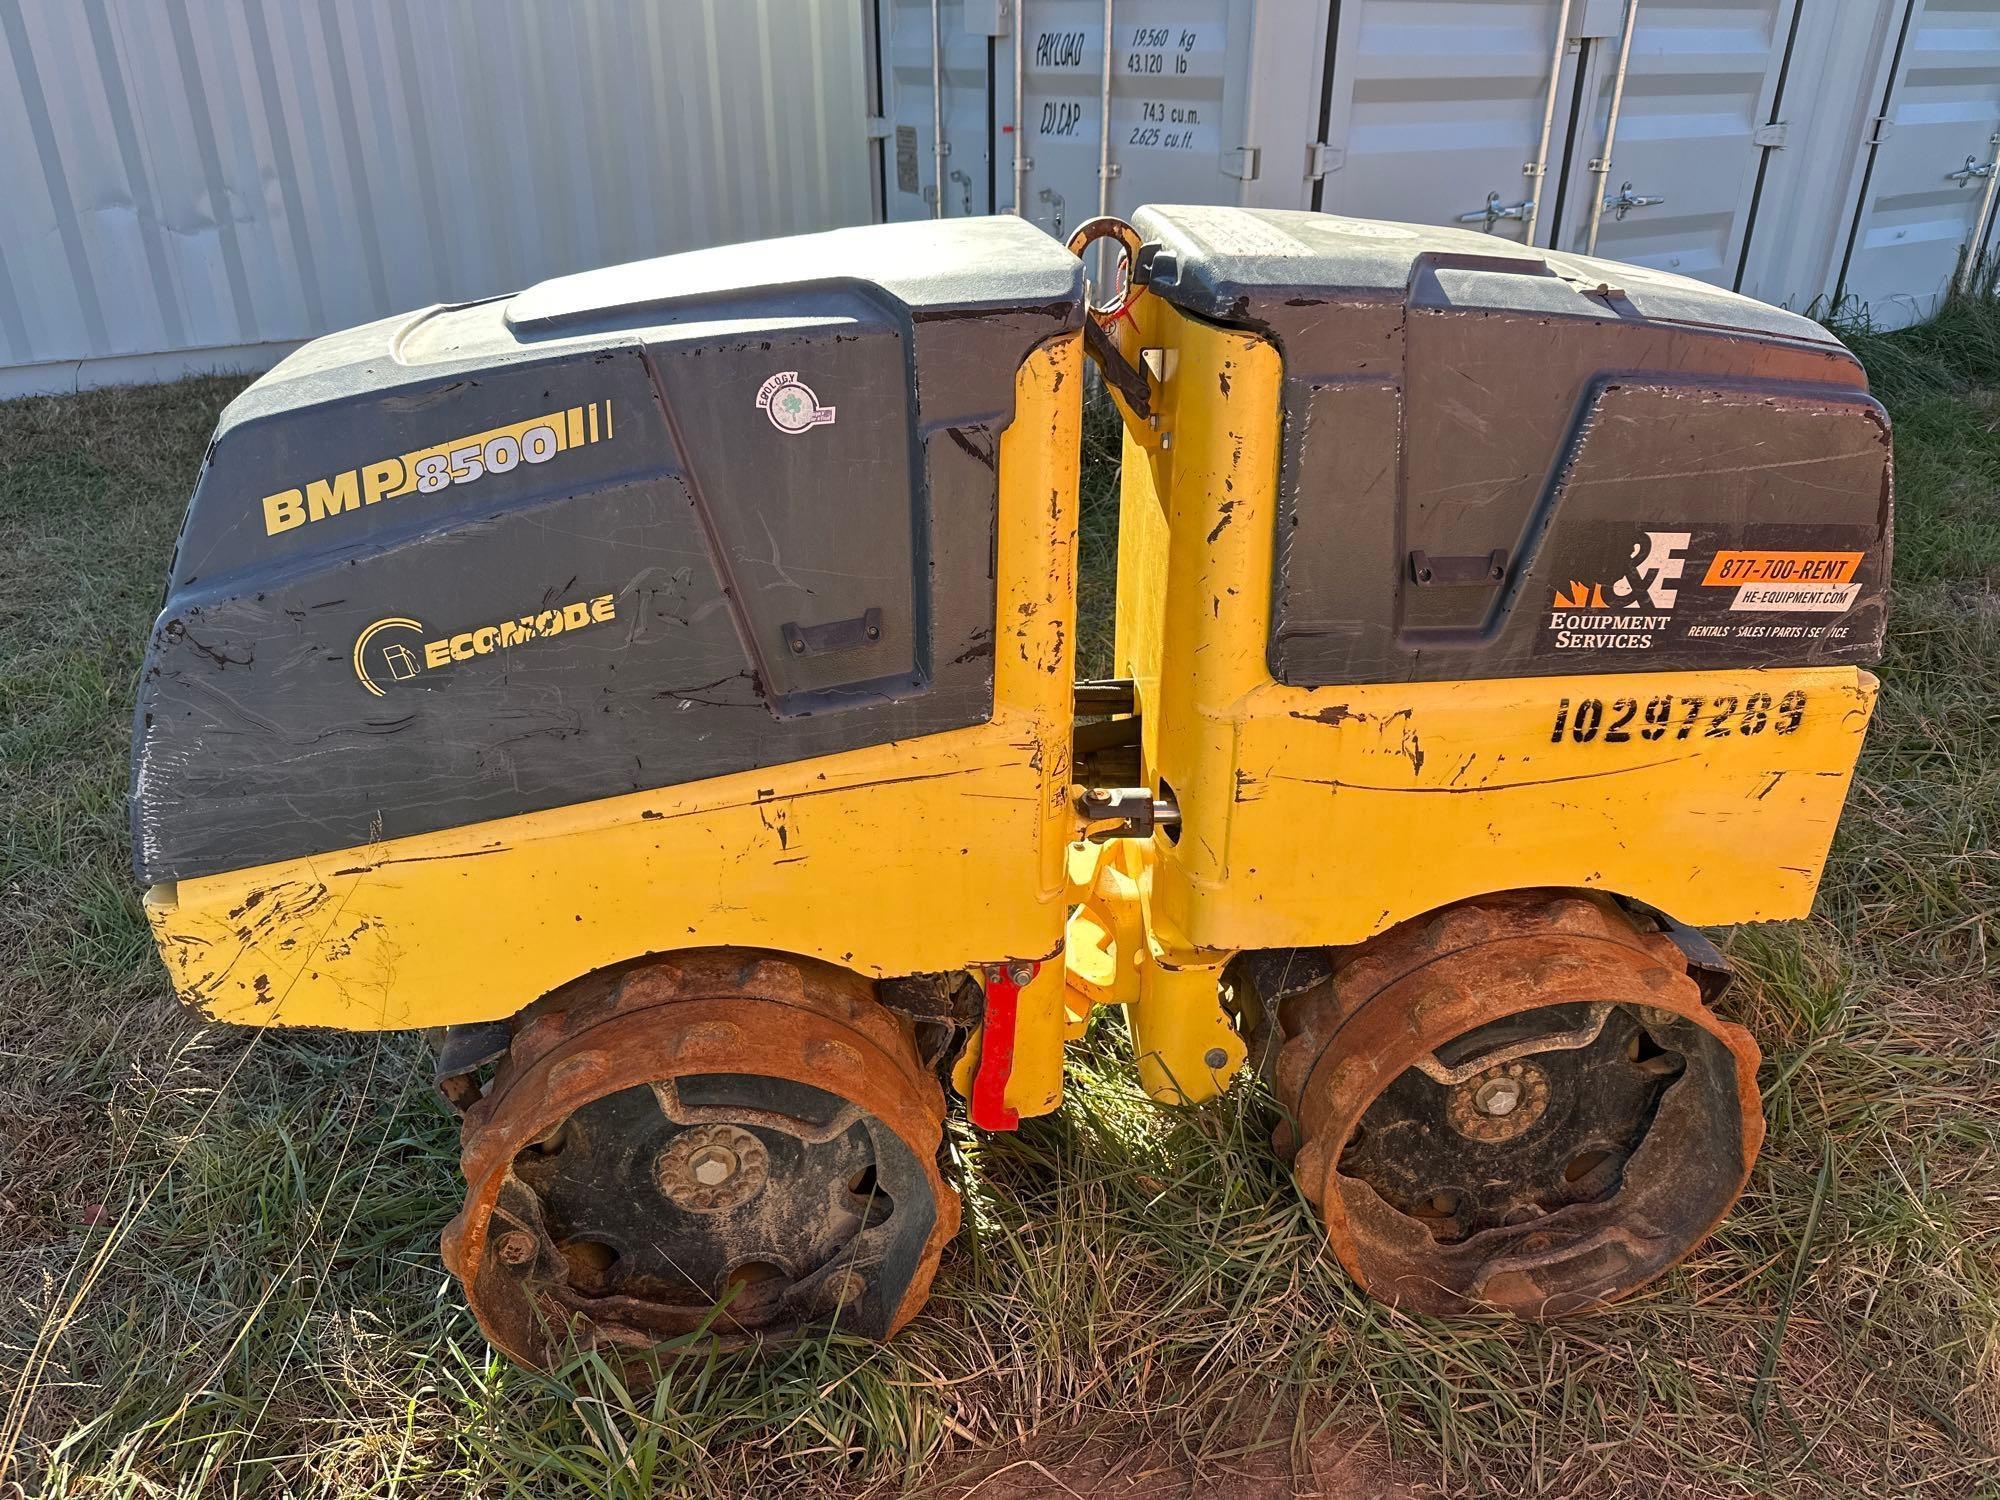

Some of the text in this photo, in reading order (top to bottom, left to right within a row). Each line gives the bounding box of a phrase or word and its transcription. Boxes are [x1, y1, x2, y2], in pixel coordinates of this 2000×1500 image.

[1036, 32, 1085, 67] PAYLOAD
[1132, 28, 1197, 52] 19.560 kg
[1128, 53, 1188, 74] 43.120 lb
[1143, 102, 1201, 125] 74.3 cu.m.
[1129, 127, 1160, 147] 2.625
[262, 425, 558, 537] BMP 8500
[1719, 559, 1849, 580] 877-700-RENT
[1742, 590, 1849, 604] HE-EQUIPMENT.COM
[424, 593, 616, 669] ECOMODE
[1548, 612, 1672, 631] EQUIPMENT
[1687, 625, 1731, 638] RENTALS
[1735, 625, 1766, 638] SALES
[1770, 626, 1803, 638] PARTS
[1555, 630, 1652, 649] SERVICES
